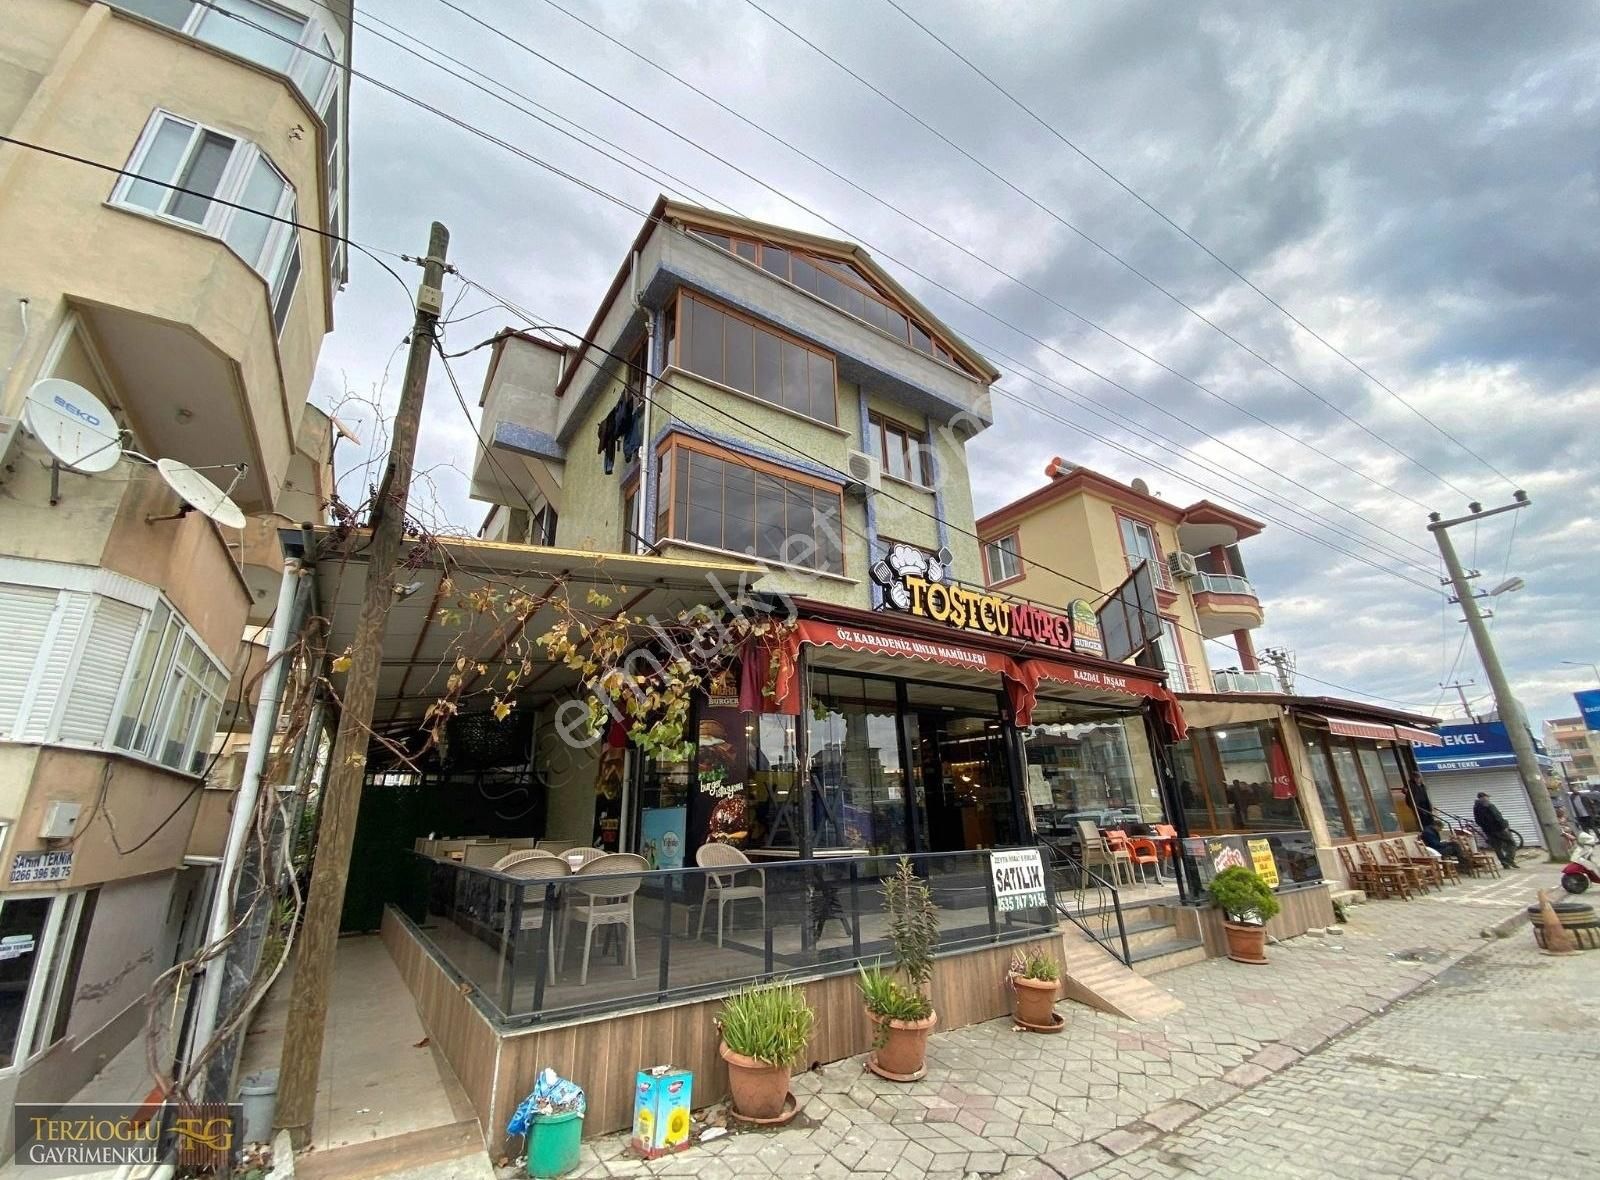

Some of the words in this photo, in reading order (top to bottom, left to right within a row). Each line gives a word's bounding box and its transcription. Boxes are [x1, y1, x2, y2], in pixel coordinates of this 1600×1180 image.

[836, 628, 852, 641] ÖZ
[853, 633, 911, 650] KARADENİZ
[996, 866, 1041, 892] SATILIK
